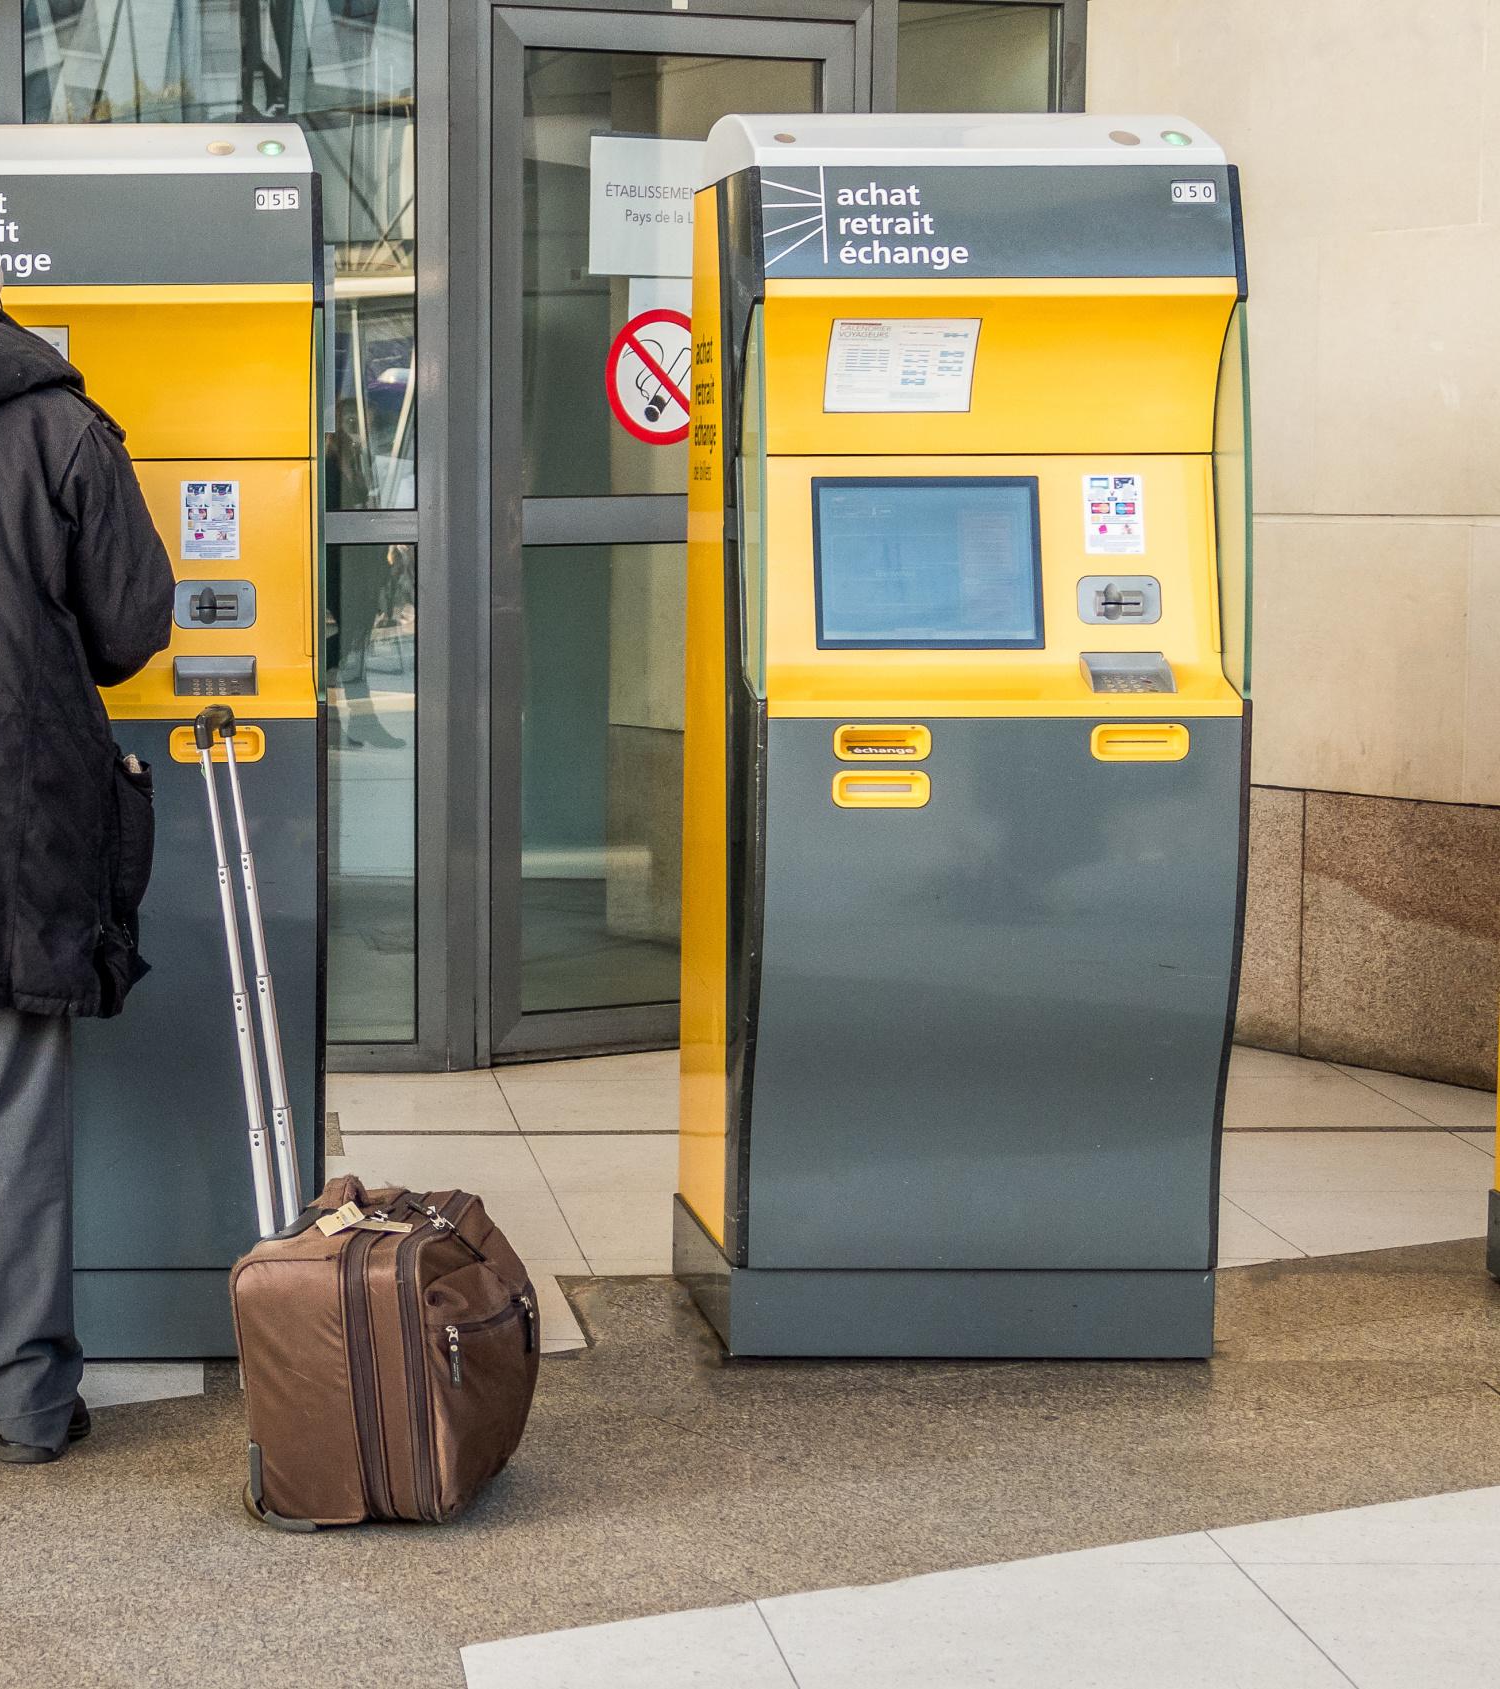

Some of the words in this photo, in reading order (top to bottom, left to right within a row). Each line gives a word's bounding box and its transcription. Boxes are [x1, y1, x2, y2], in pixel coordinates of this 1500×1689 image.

[256, 193, 296, 206] 055
[837, 181, 921, 206] achat
[1173, 185, 1212, 198] 050
[625, 209, 651, 226] Pays
[655, 210, 669, 223] de
[674, 210, 683, 224] la
[839, 211, 935, 235] retrait
[839, 240, 969, 270] échange
[696, 333, 713, 365] achat
[695, 373, 715, 405] retrait
[694, 416, 717, 455] échange
[853, 747, 914, 755] échange
